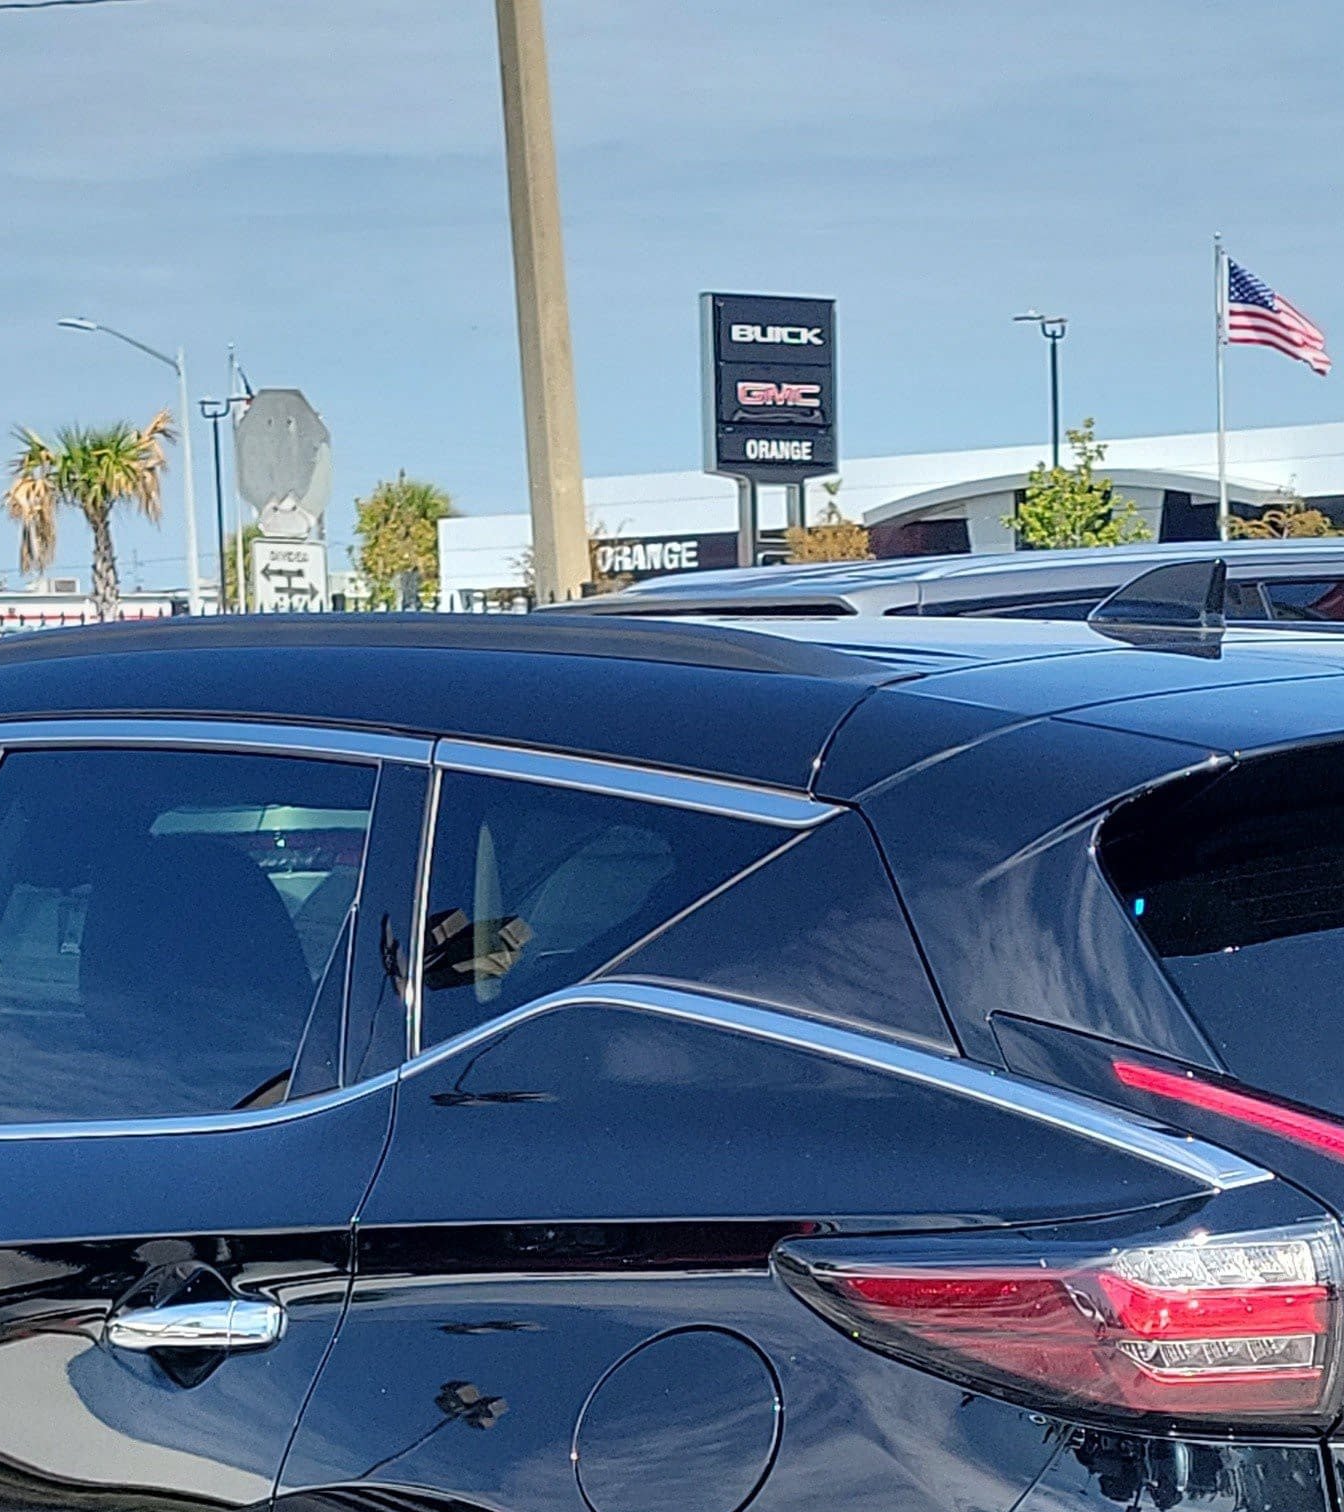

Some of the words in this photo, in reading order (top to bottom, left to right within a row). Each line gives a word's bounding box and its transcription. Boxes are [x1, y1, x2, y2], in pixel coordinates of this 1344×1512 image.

[731, 324, 823, 345] BUICK
[737, 382, 821, 407] GMC
[745, 439, 812, 461] ORANGE
[597, 541, 698, 572] ORANGE
